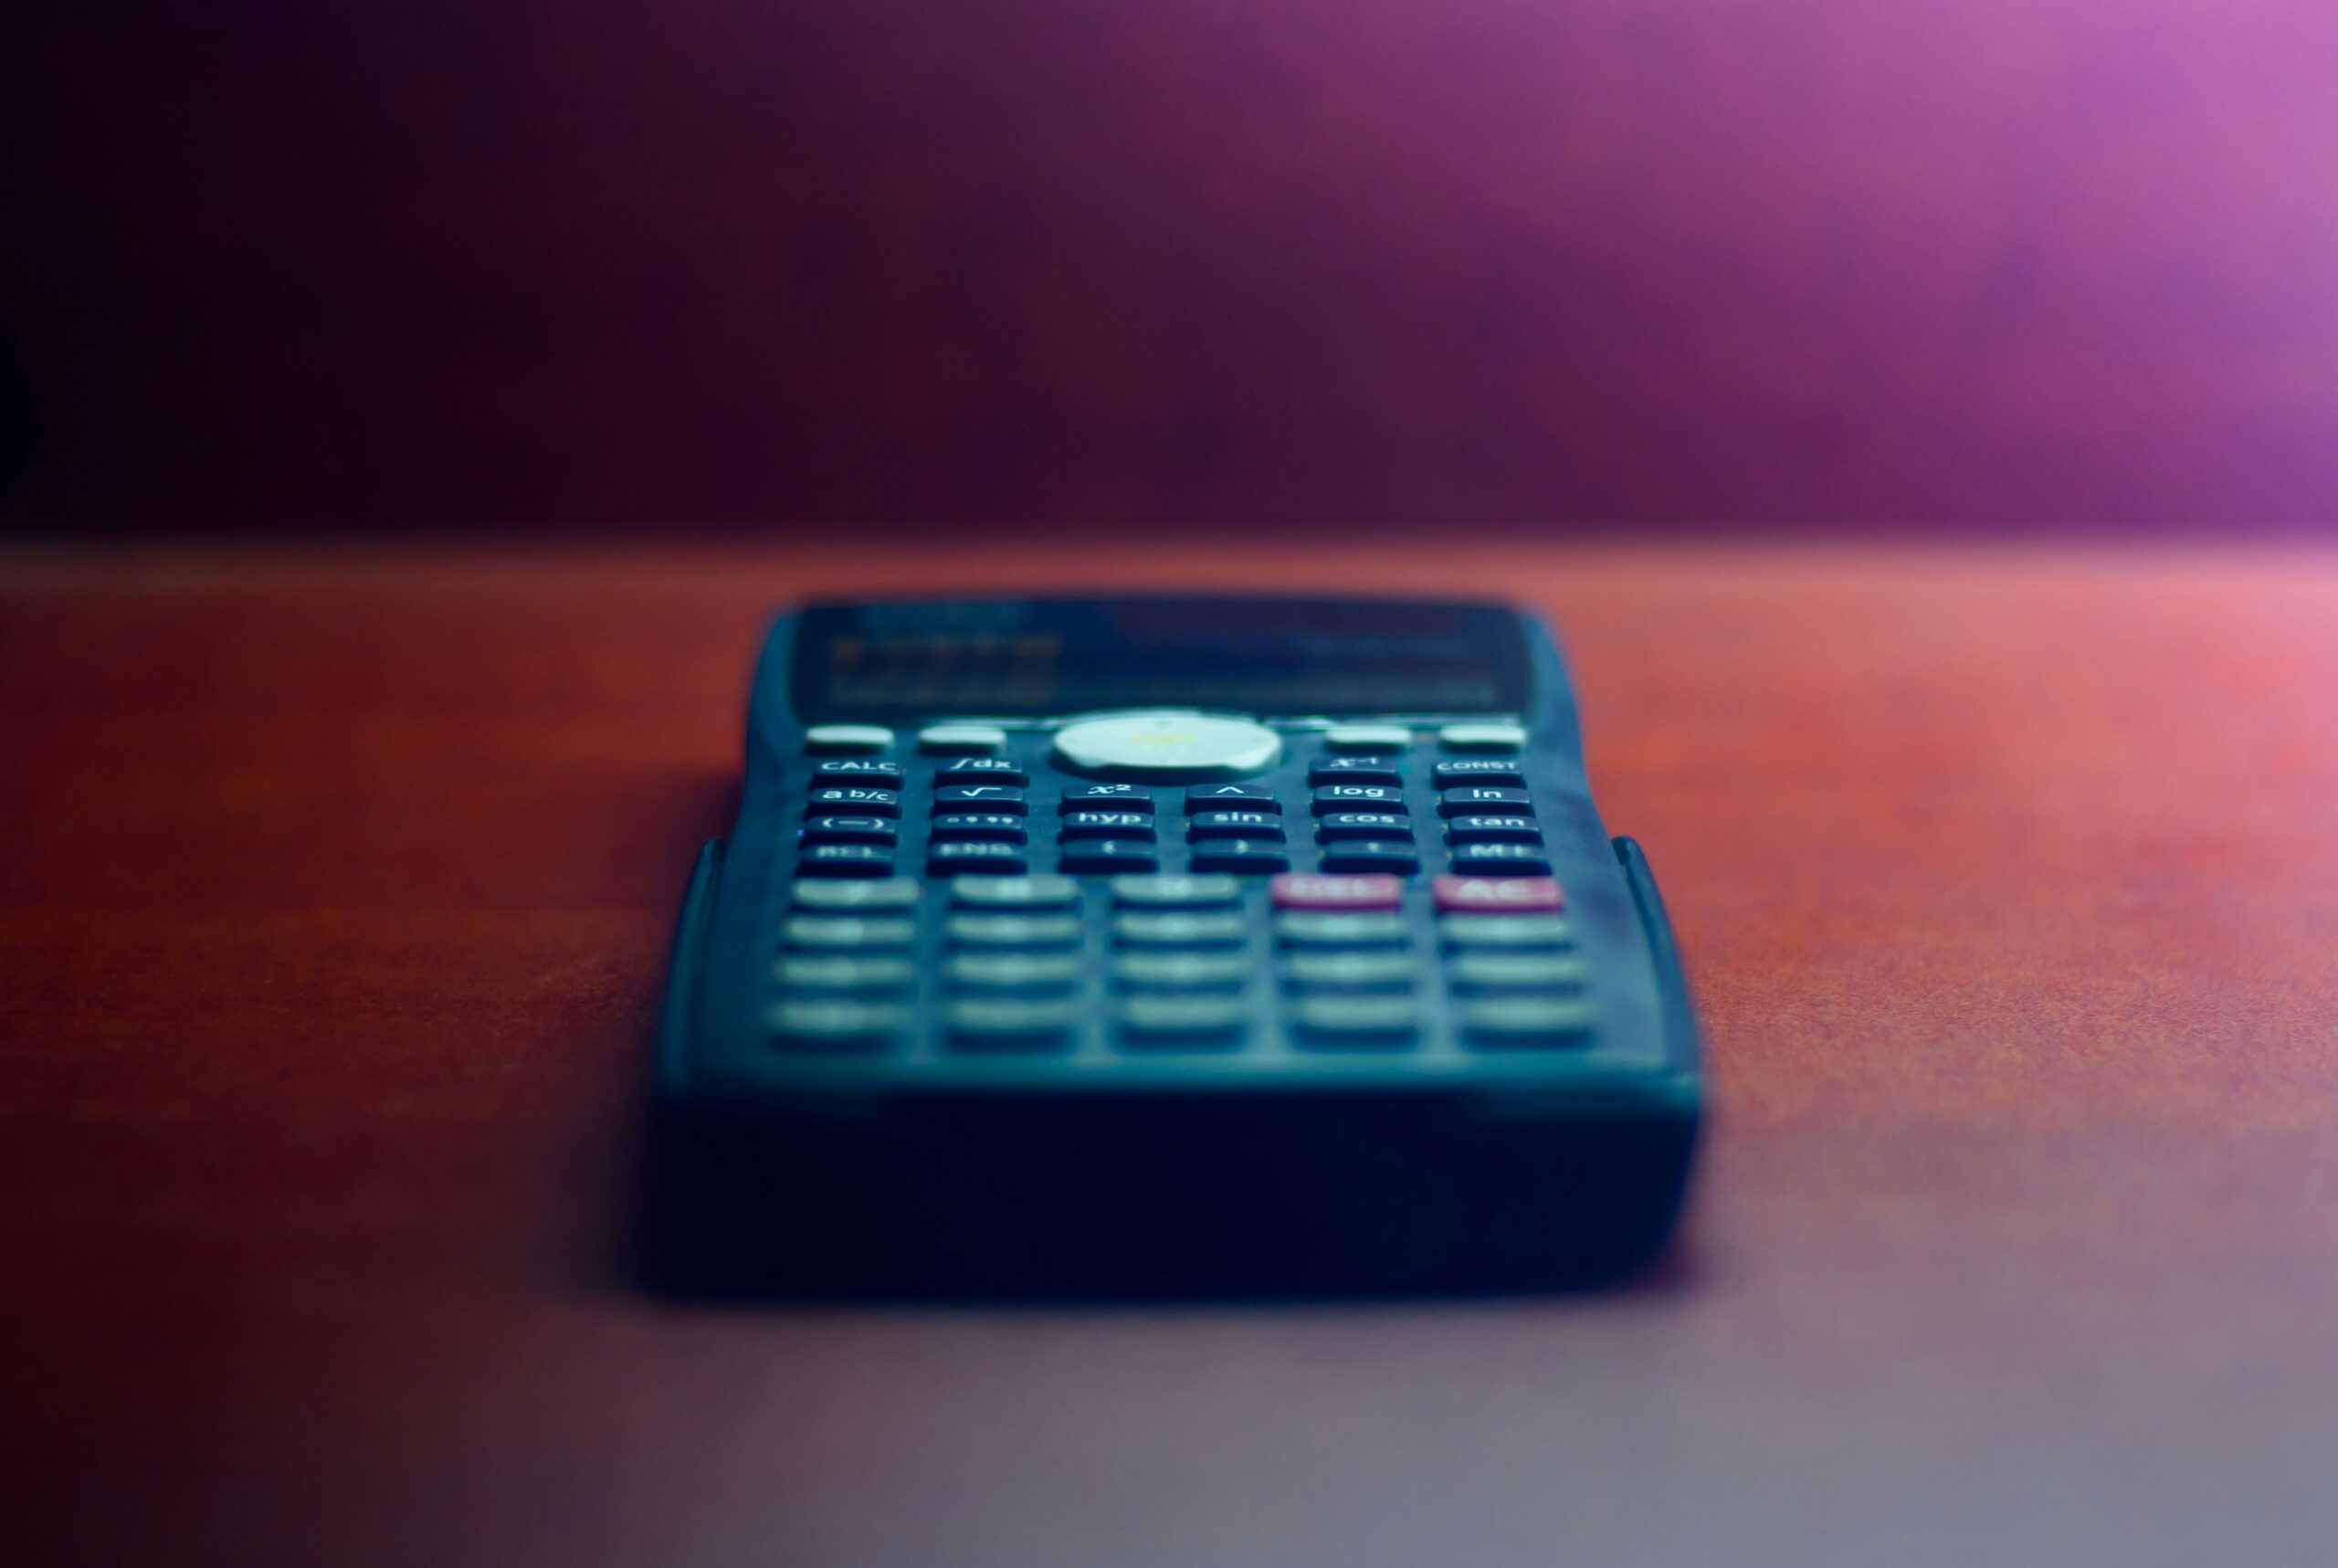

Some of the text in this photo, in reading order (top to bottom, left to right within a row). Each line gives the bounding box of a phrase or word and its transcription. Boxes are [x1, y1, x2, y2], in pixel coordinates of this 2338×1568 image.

[822, 761, 897, 771] CALC
[1437, 761, 1517, 771] CONST
[1333, 785, 1385, 797] log
[1078, 811, 1142, 825] hyp
[1213, 811, 1263, 823] sin
[1339, 814, 1396, 824] cos
[1468, 816, 1526, 826] tan
